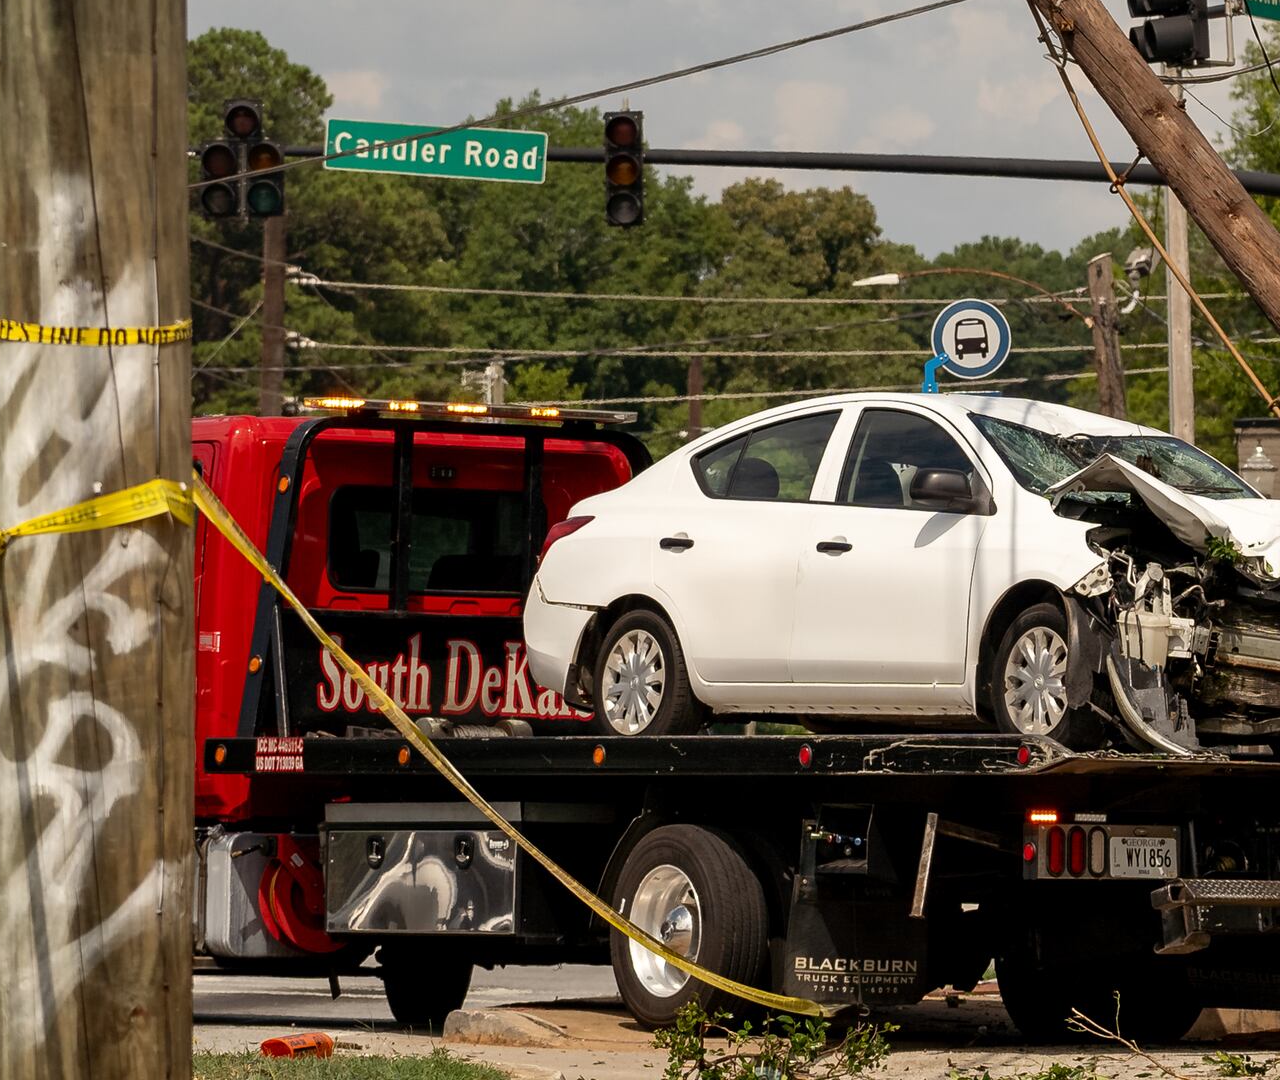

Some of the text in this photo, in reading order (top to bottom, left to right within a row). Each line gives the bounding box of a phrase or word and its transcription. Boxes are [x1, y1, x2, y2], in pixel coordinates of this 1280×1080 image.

[334, 131, 539, 170] Candler Road
[317, 632, 596, 720] South DeKa
[256, 756, 264, 770] US
[794, 957, 918, 972] BLACKBURN
[796, 973, 916, 984] TRUCK EQUIPMENT
